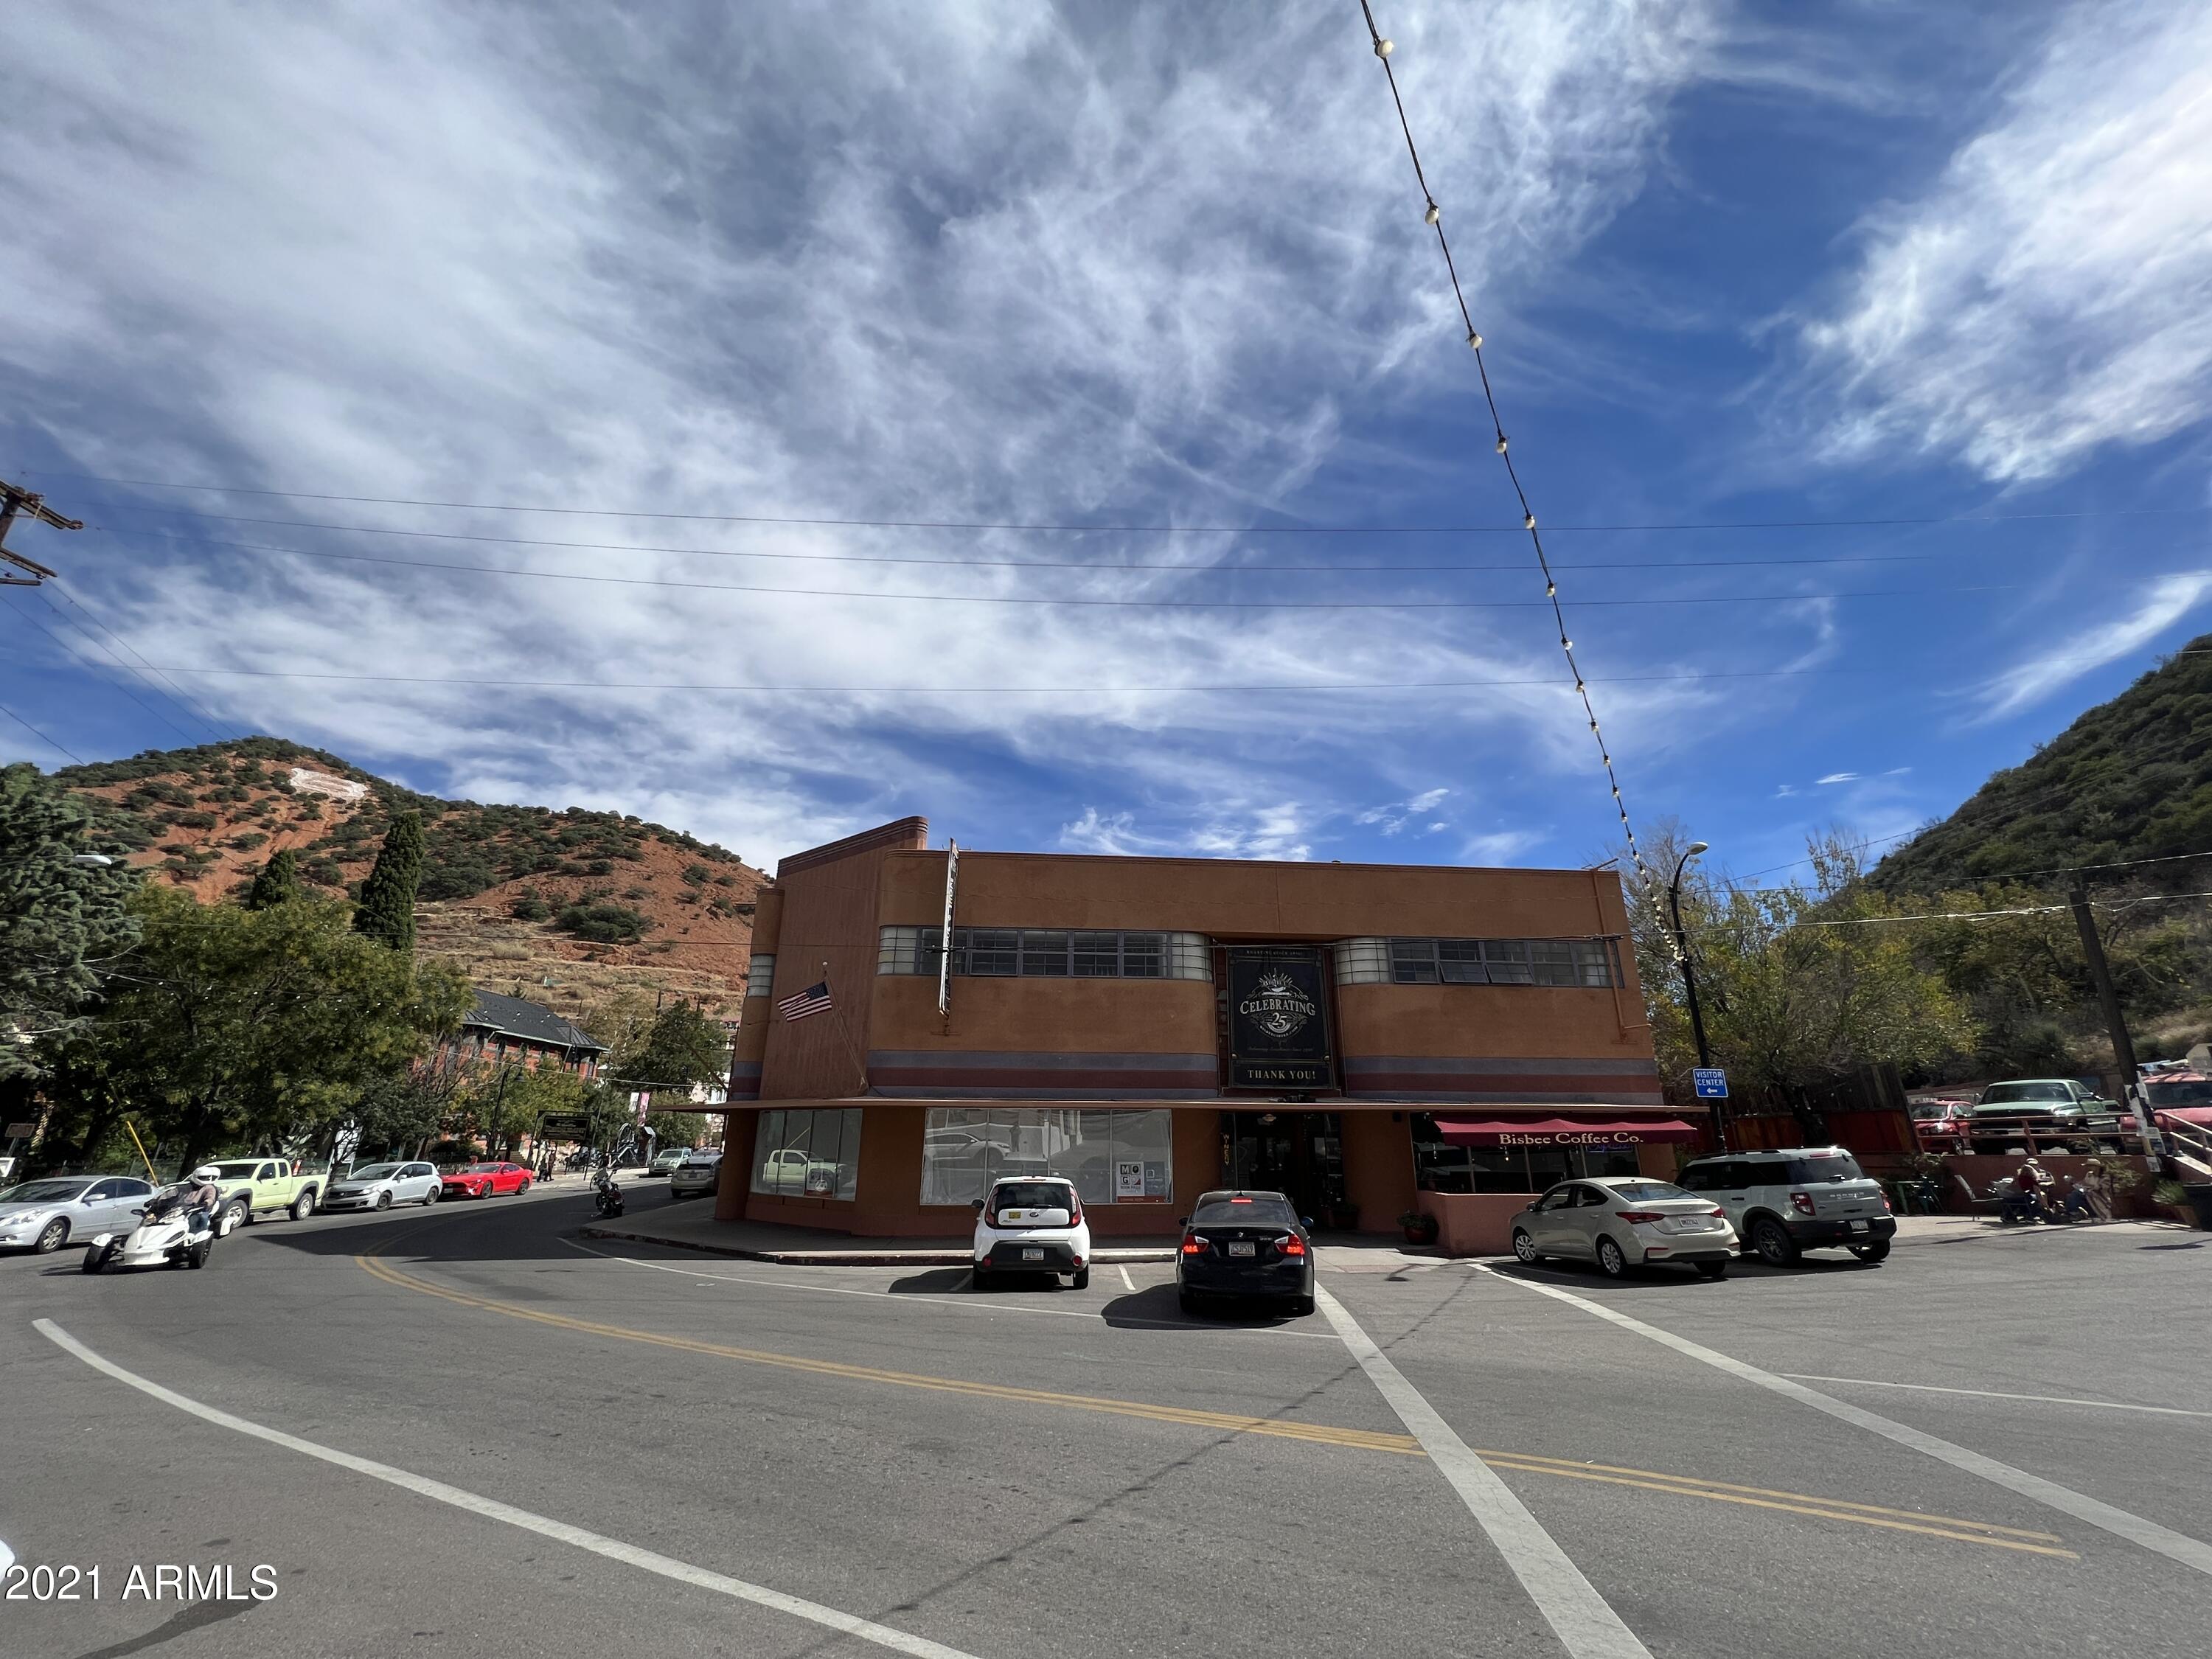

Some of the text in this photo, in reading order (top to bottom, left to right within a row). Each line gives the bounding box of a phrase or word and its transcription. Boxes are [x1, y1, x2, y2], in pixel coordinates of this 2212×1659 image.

[1240, 998, 1315, 1015] CELEBRATING
[1271, 1012, 1287, 1029] 25
[1248, 1070, 1316, 1079] THANK YOU!
[1499, 1132, 1644, 1144] Bisbee Coffee Co.
